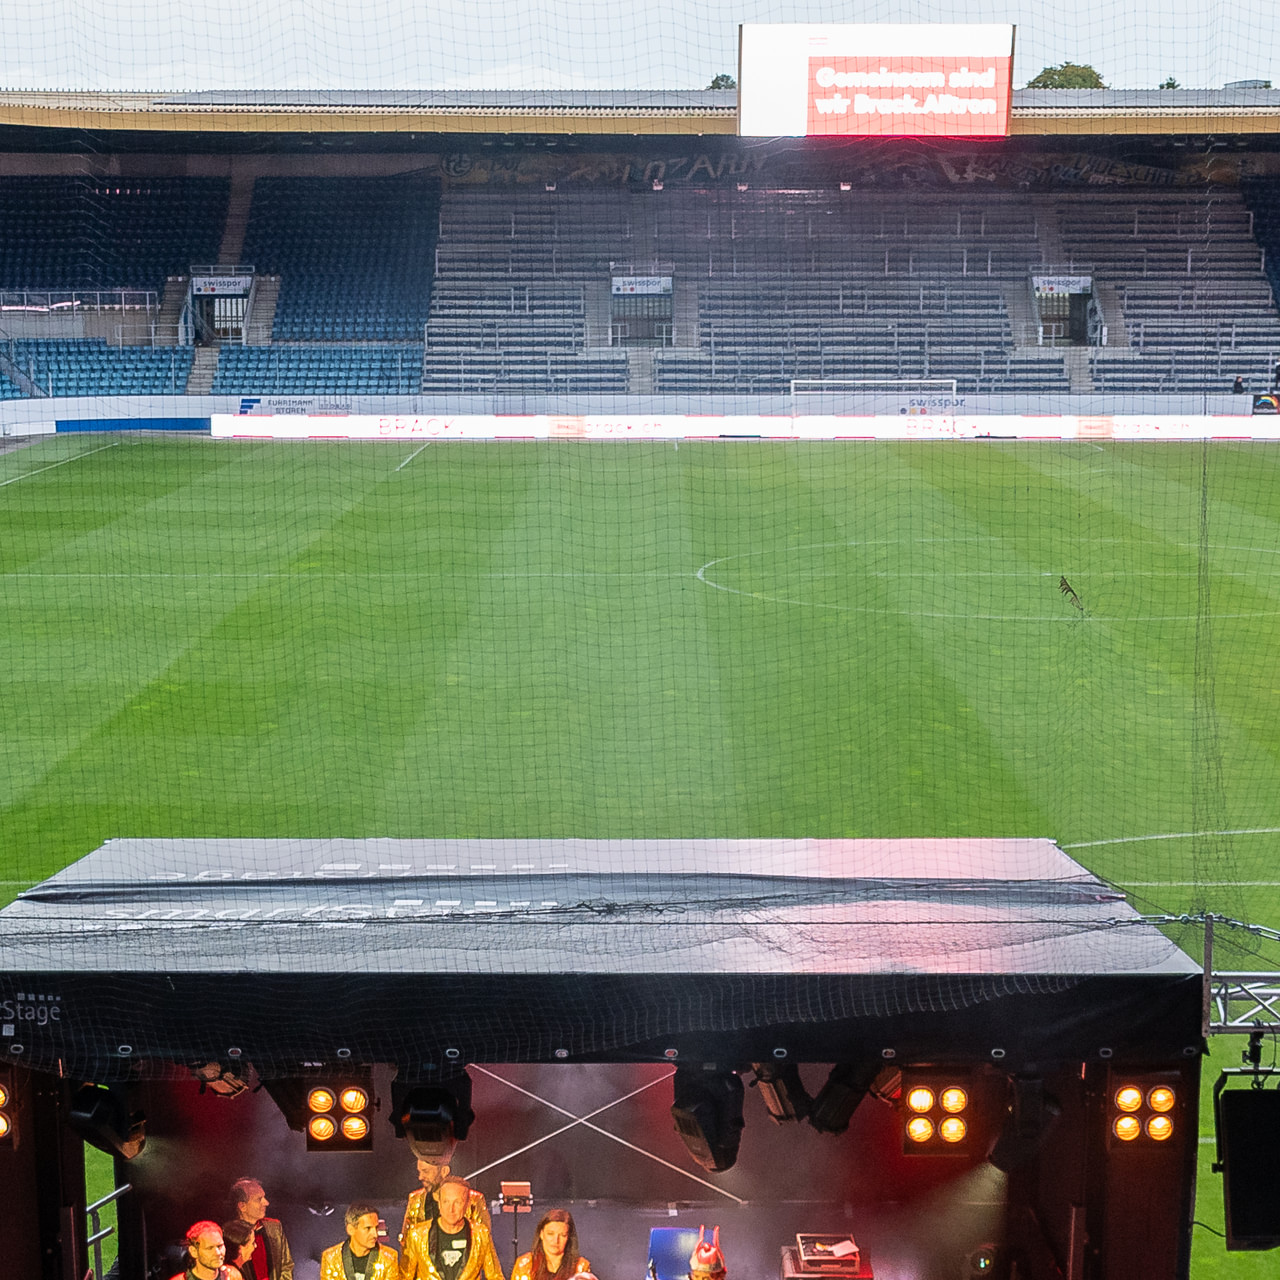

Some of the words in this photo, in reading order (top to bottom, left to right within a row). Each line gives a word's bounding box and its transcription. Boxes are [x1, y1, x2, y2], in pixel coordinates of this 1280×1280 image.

[816, 67, 945, 88] Gemeinsam
[949, 67, 996, 88] sind
[815, 94, 851, 114] wir
[203, 279, 241, 288] swisspor
[622, 278, 661, 288] swisspor
[1042, 279, 1081, 288] swisspor
[909, 397, 966, 408] swisspor
